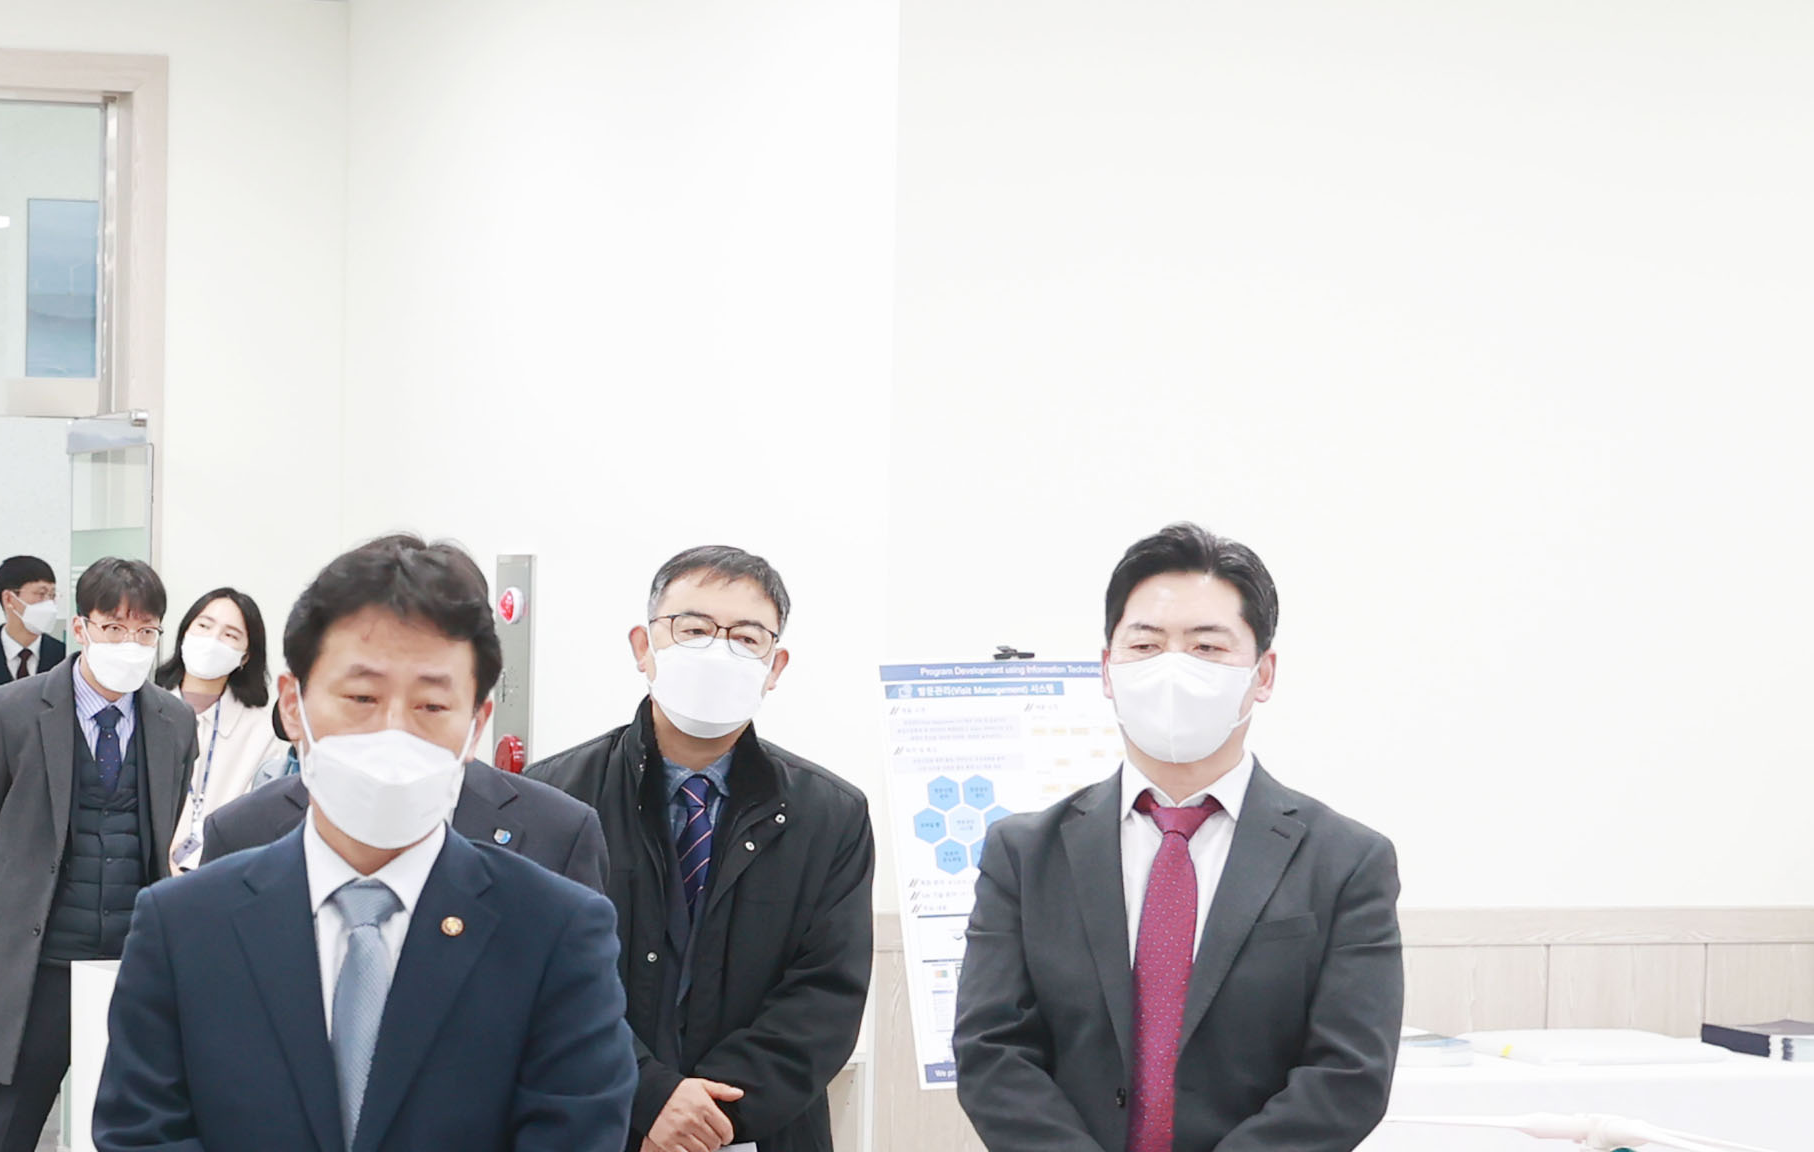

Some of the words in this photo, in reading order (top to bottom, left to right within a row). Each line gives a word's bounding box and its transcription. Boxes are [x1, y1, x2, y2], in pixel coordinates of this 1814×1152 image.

[920, 667, 953, 677] Program
[955, 666, 1003, 676] Development
[1005, 667, 1025, 676] using
[1026, 665, 1066, 674] Information
